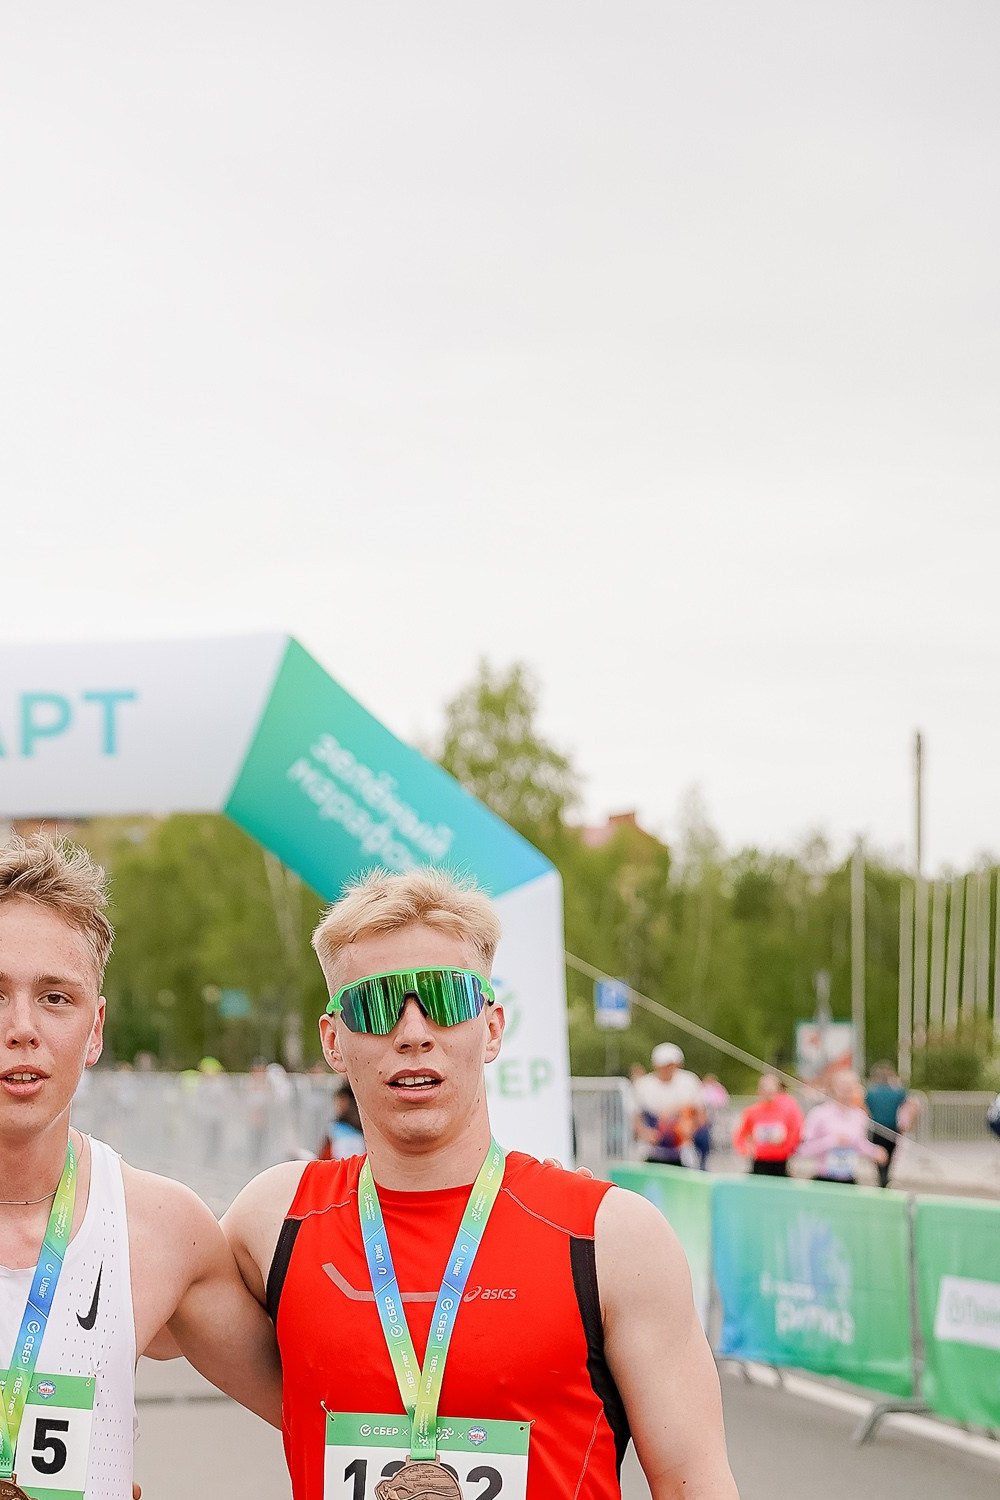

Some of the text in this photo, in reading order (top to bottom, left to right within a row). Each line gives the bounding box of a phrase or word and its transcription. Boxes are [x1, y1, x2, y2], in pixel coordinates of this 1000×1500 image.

[373, 1244, 385, 1264] Utair
[452, 1257, 466, 1277] Utair
[38, 1277, 51, 1299] Utair
[384, 1296, 398, 1324] СБЕР
[435, 1313, 449, 1342] СБЕР
[21, 1335, 35, 1365] СБЕР
[405, 1370, 415, 1389] 185
[424, 1354, 438, 1395] 185 лет
[7, 1376, 23, 1416] 185 лет
[372, 1425, 399, 1435] СБЕР
